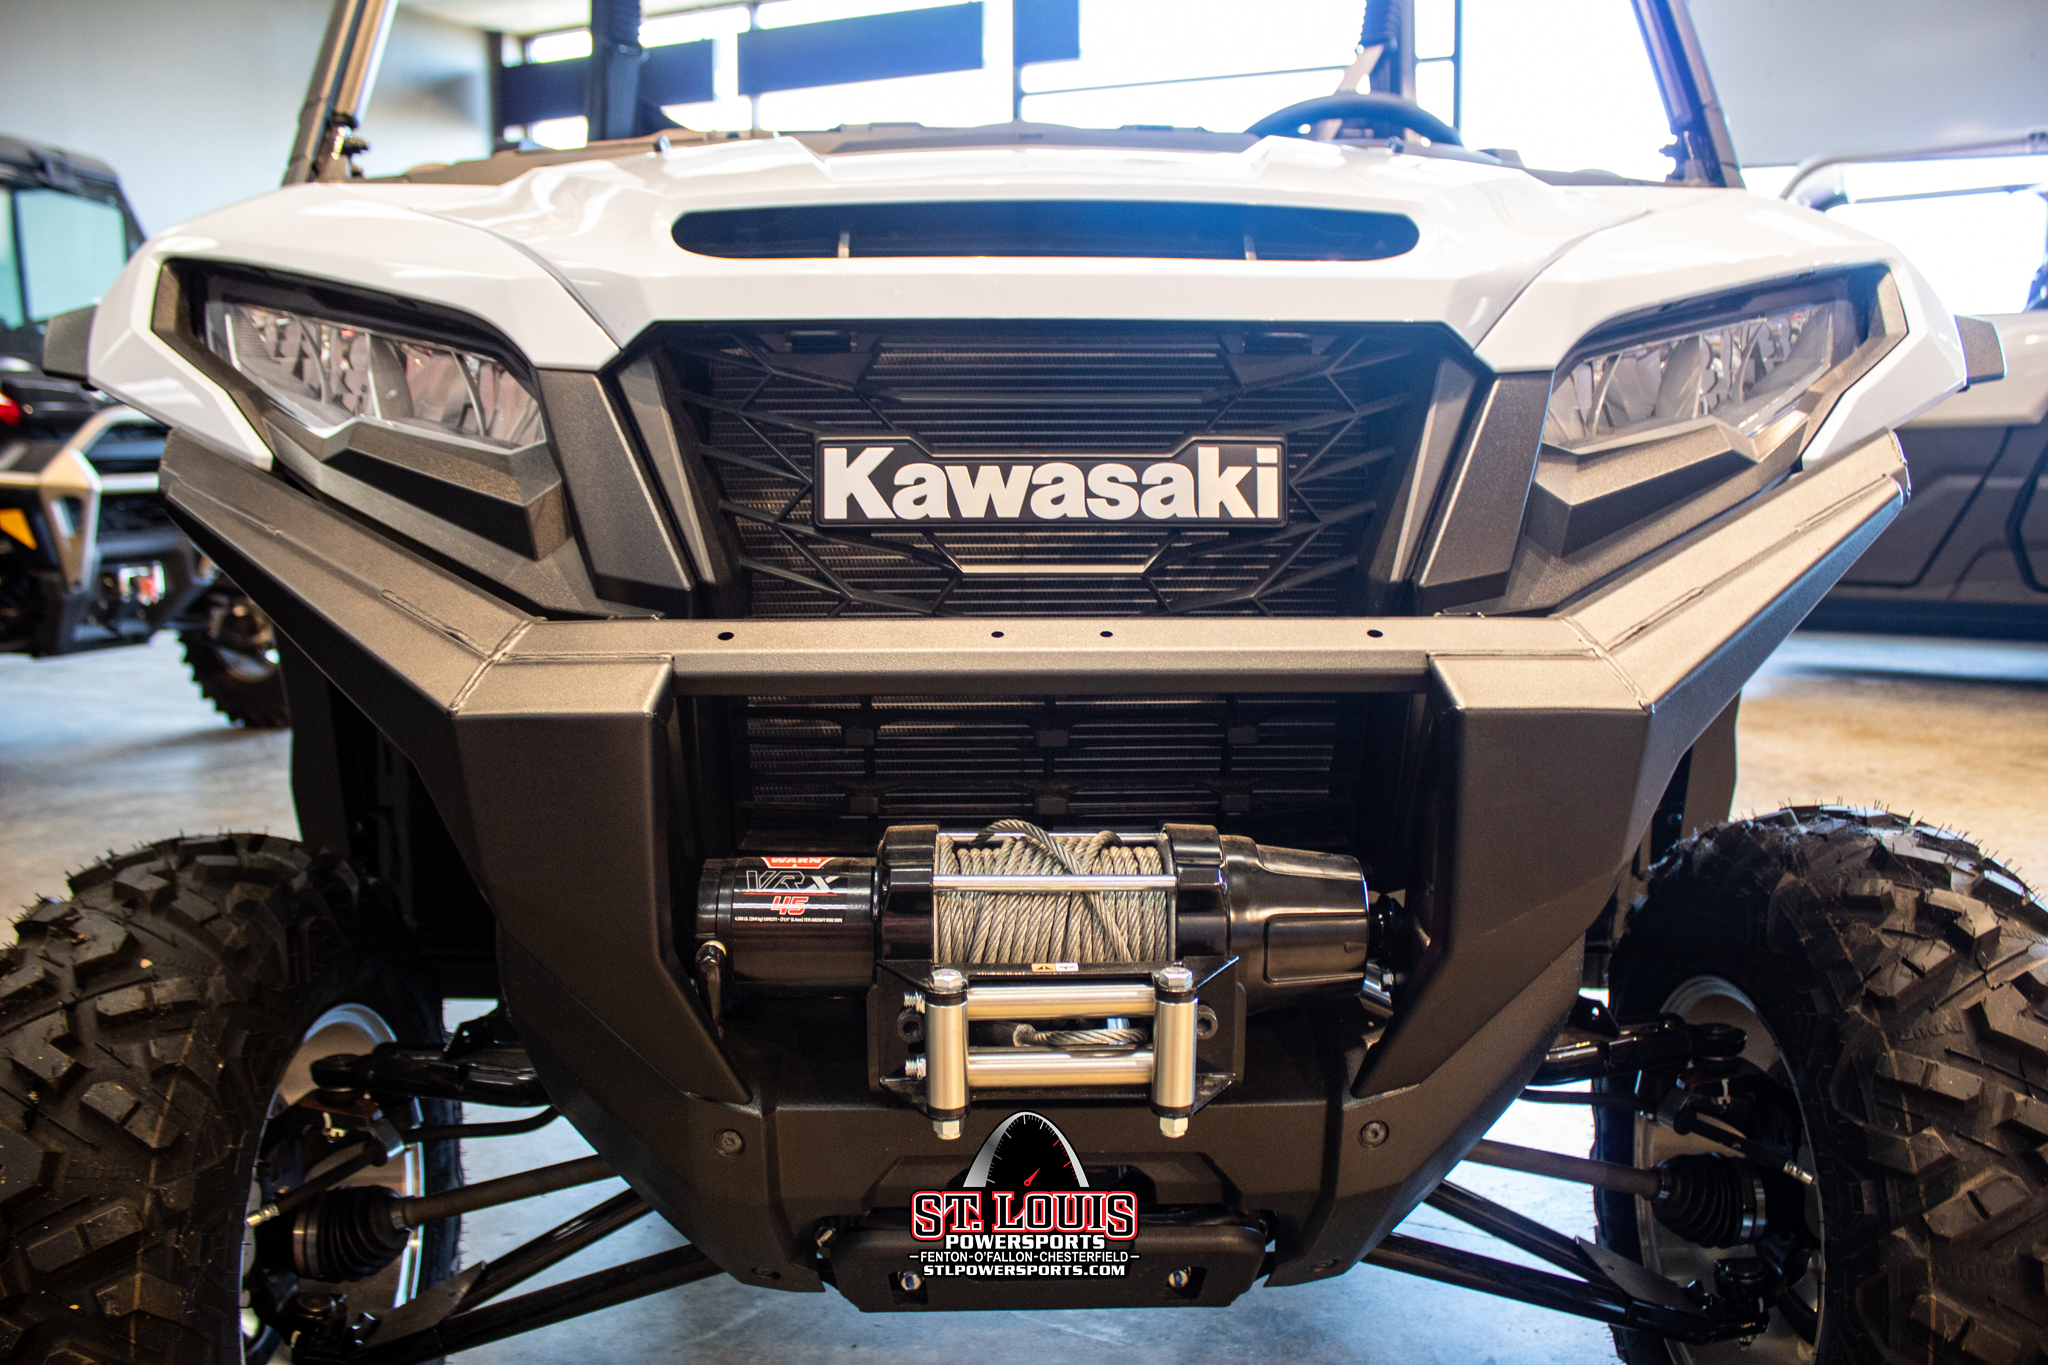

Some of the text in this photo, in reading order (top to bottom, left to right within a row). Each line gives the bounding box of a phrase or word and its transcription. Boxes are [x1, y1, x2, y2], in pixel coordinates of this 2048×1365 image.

[823, 446, 1279, 521] Kawasaki
[746, 870, 840, 892] VRX
[770, 896, 809, 916] 45
